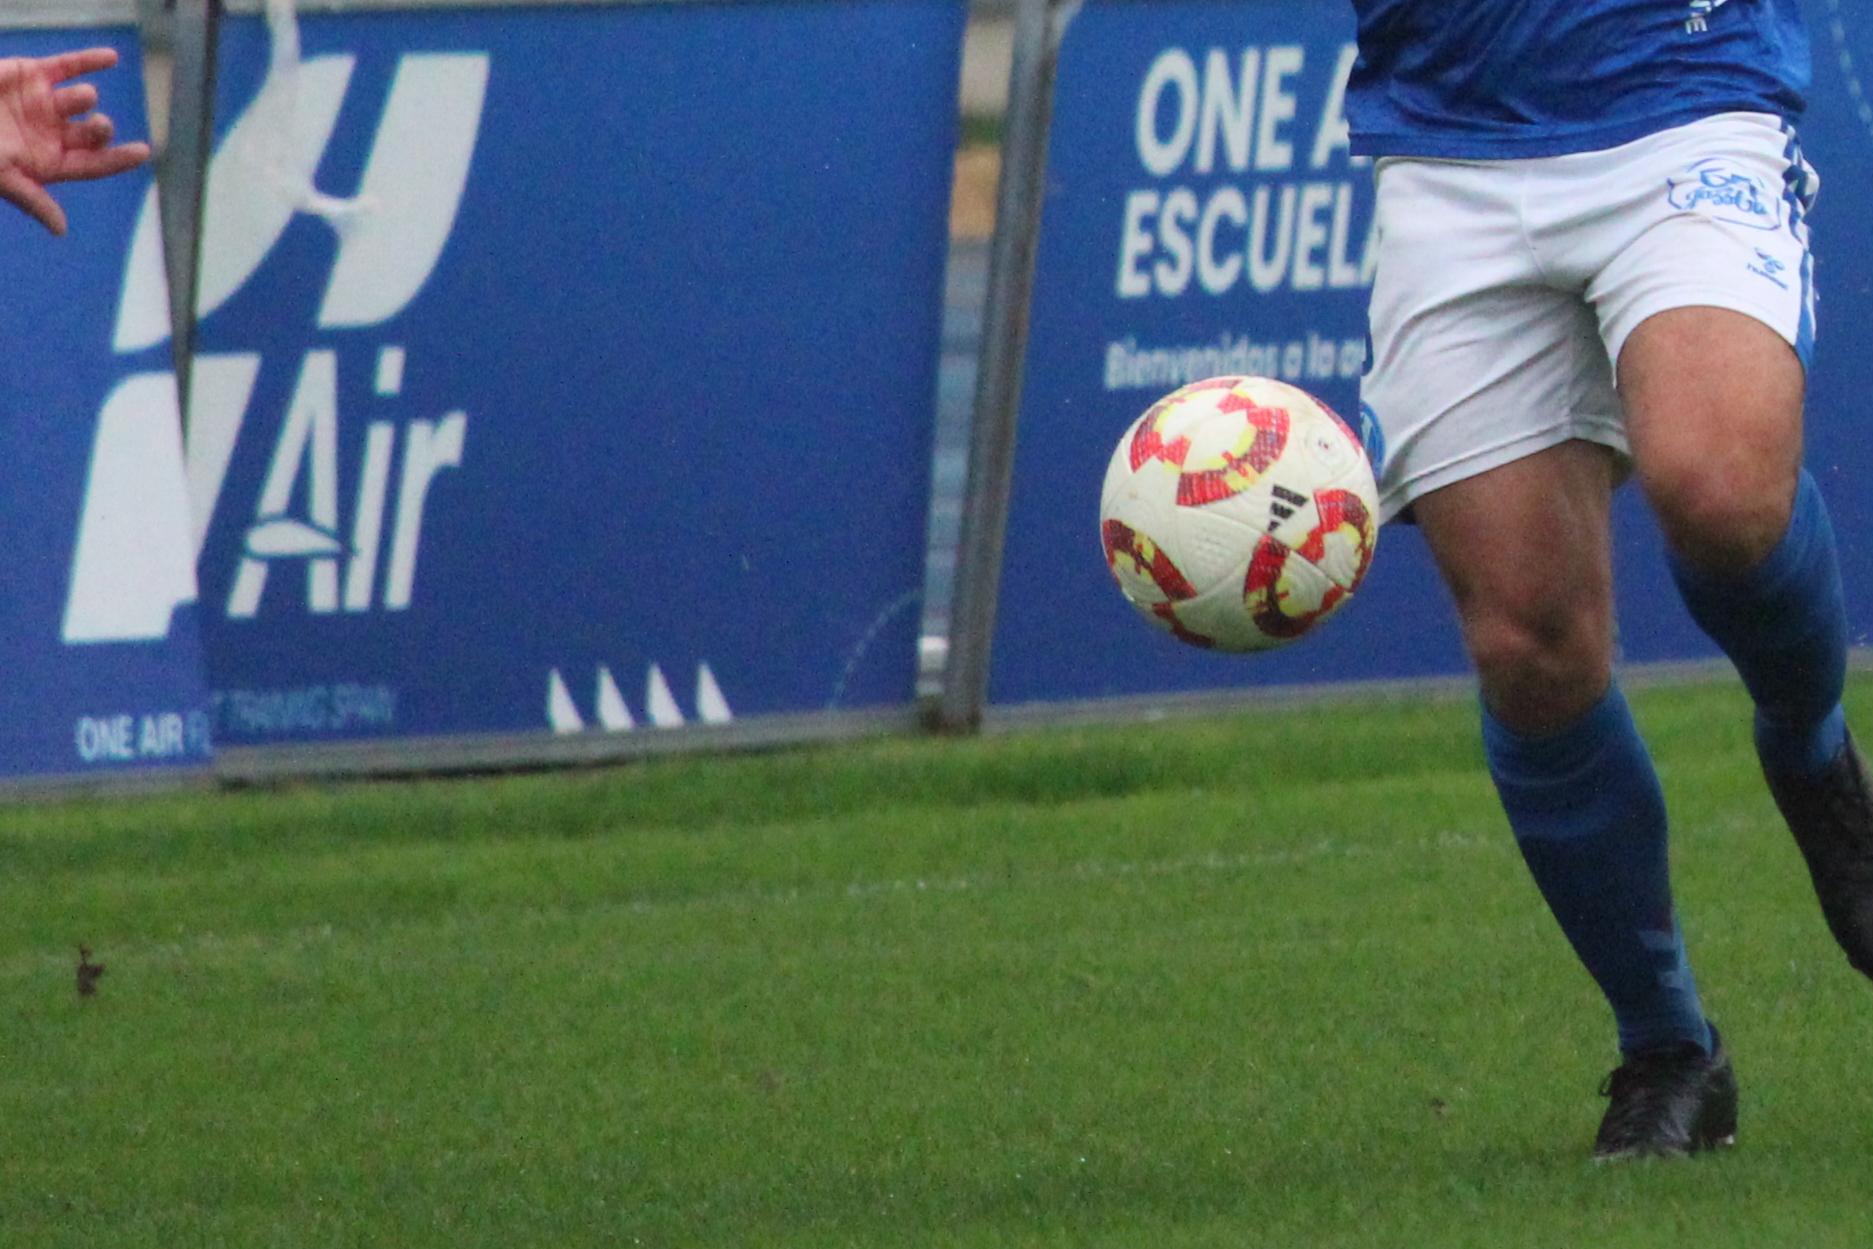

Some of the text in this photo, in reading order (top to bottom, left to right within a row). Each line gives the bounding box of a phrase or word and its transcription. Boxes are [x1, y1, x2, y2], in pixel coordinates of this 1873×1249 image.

[1136, 45, 1304, 177] ONE
[76, 713, 135, 762] ONE
[138, 709, 186, 756] AIR
